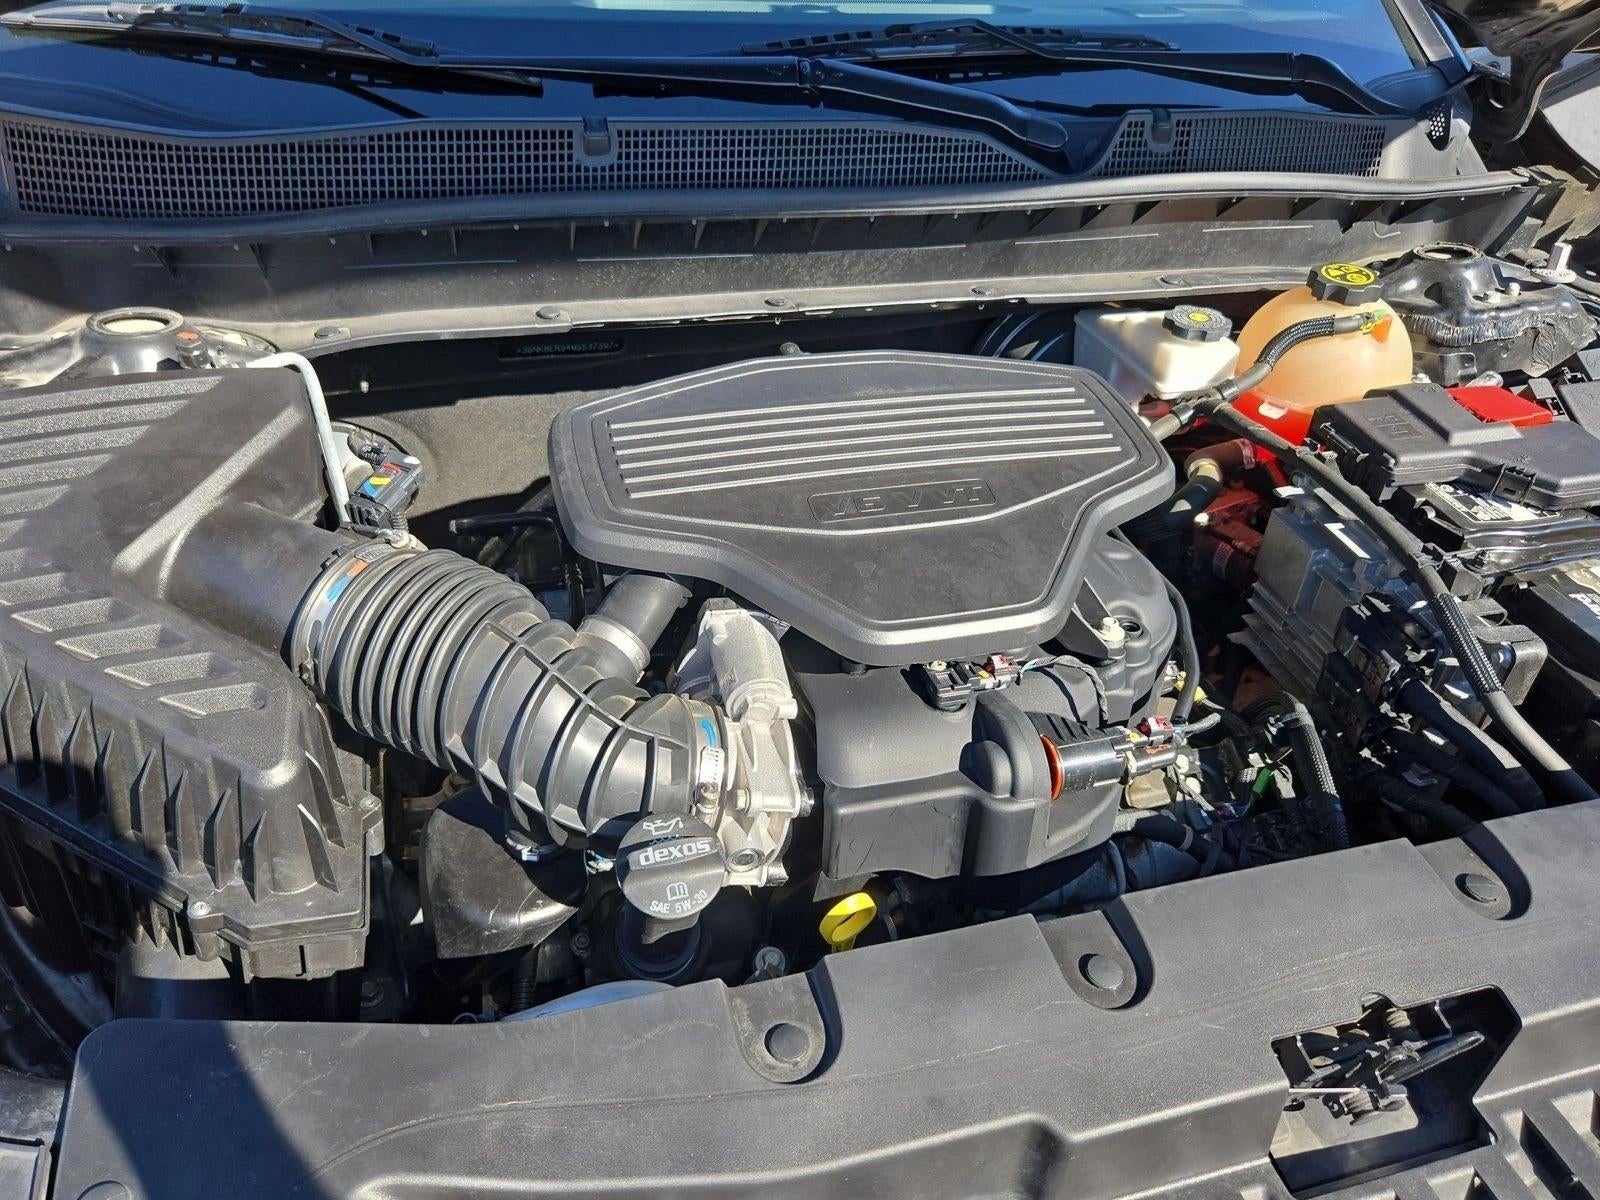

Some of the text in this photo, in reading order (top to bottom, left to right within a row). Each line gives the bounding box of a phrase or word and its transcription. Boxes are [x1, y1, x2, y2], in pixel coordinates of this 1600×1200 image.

[817, 486, 983, 516] V6 VVT
[639, 840, 712, 866] dexos
[650, 889, 708, 913] SAE 5W-30
